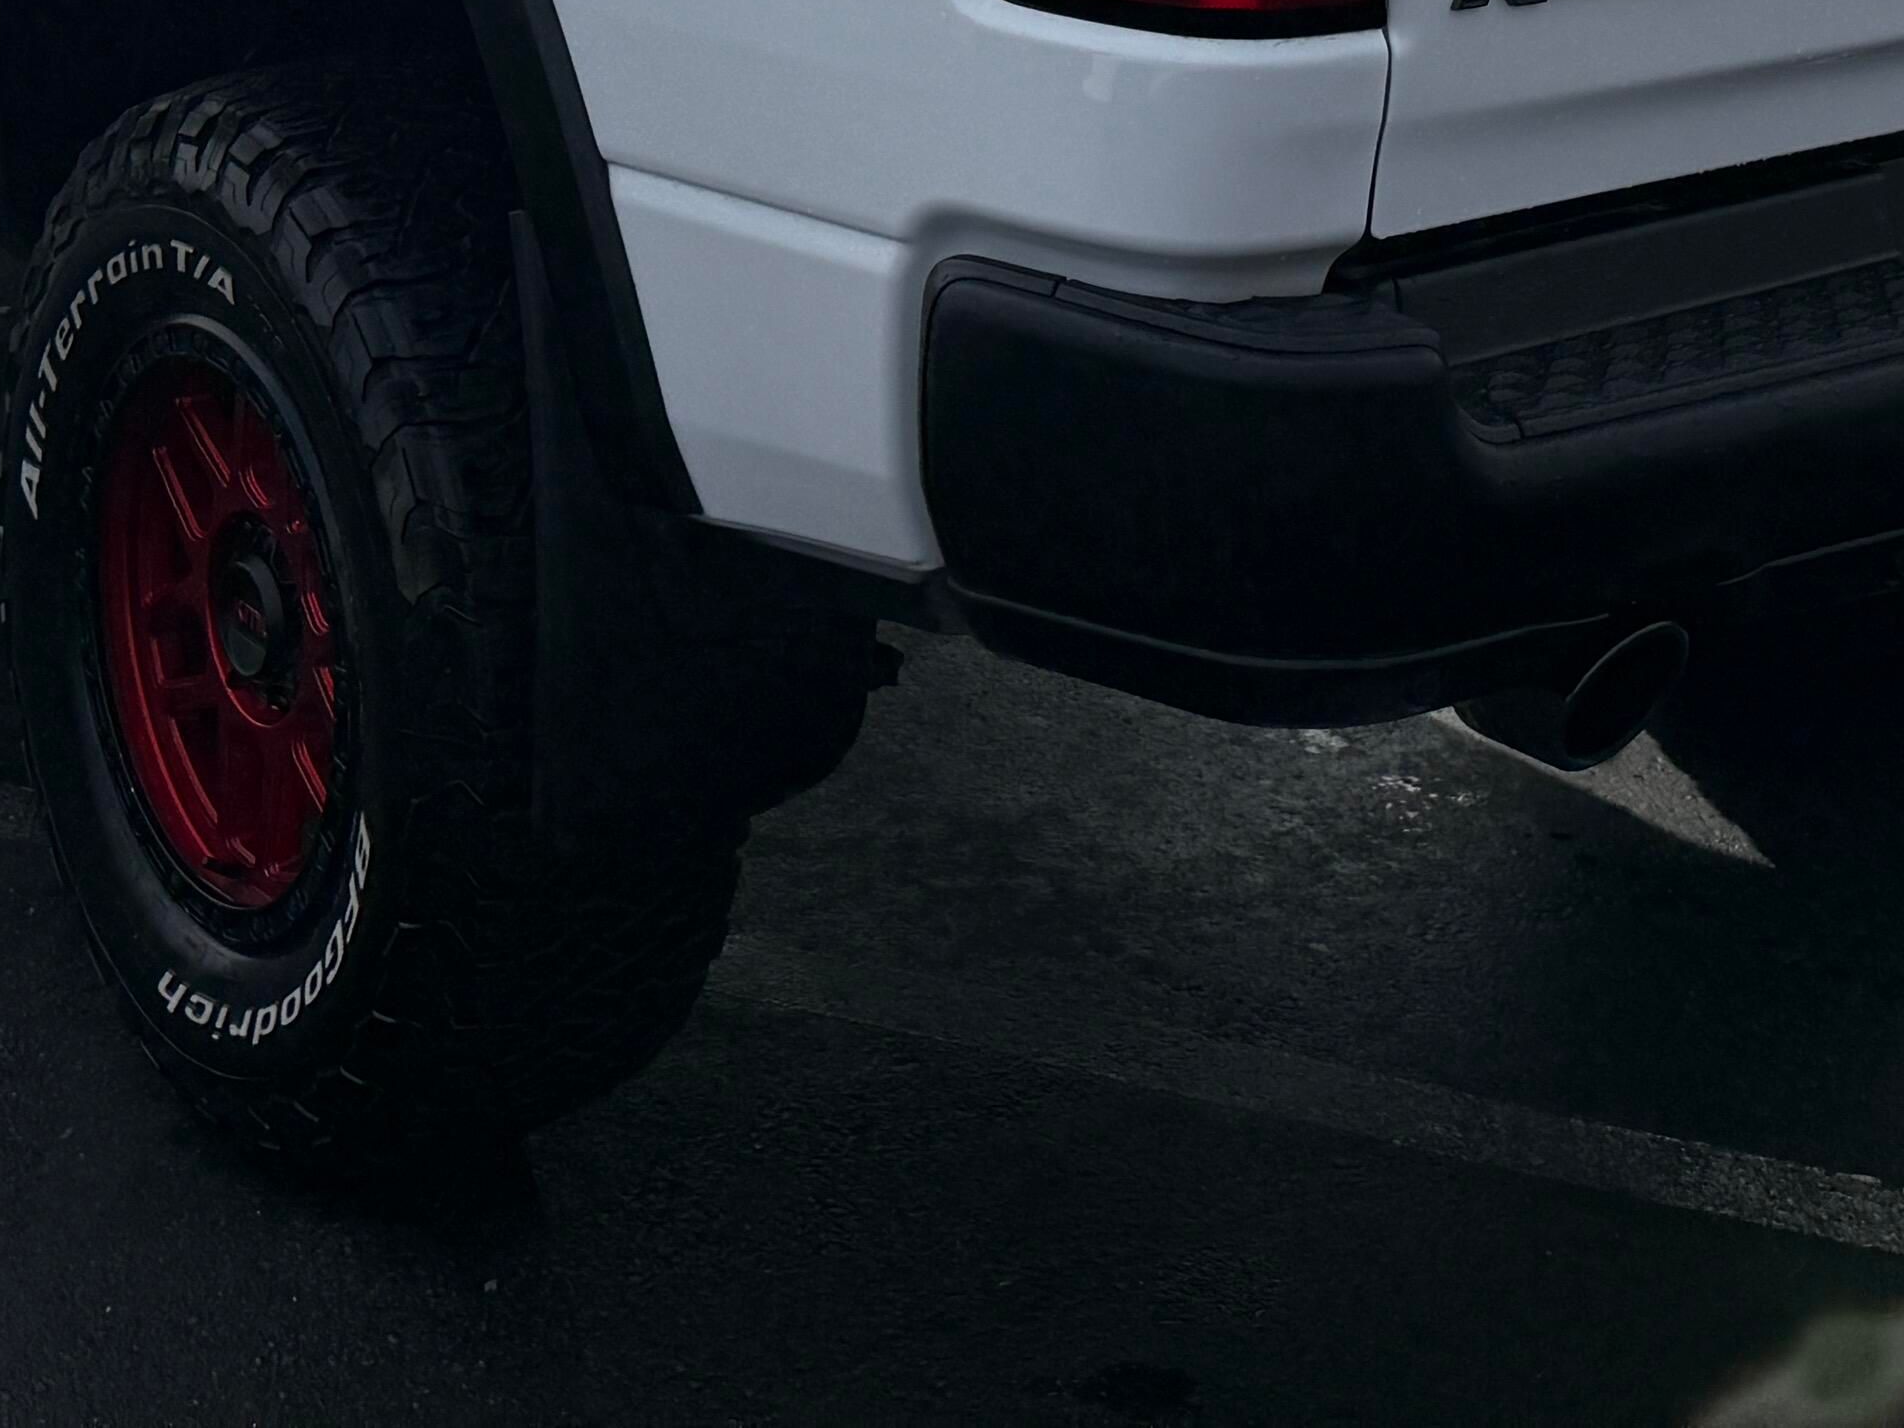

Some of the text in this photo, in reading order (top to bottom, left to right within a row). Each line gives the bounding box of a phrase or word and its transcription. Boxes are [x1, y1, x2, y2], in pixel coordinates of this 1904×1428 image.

[18, 237, 239, 520] All-Terrain T/A
[156, 810, 373, 1048] BFGoodrich
